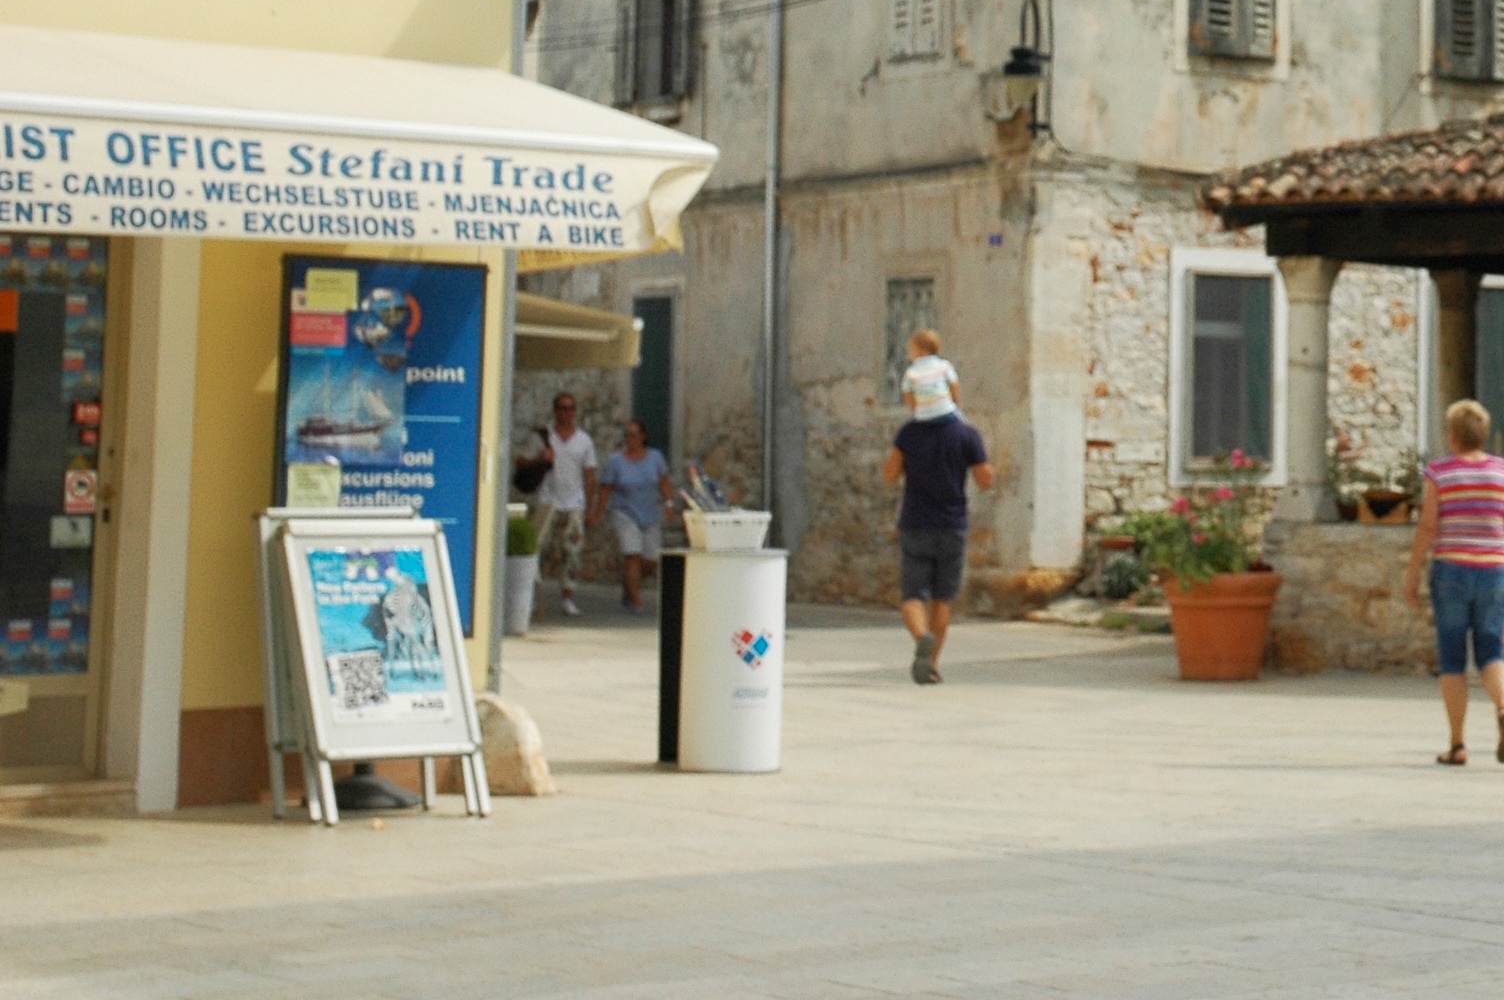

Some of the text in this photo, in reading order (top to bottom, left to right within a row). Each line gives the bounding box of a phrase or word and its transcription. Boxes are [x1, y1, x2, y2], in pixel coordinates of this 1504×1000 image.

[4, 125, 614, 194] IST OFFICE Stefani Trade
[62, 174, 176, 199] CAMBIO
[202, 180, 420, 211] WECHSELSTUBE
[110, 206, 208, 232] ROOMS
[244, 211, 416, 238] EXCURSIONS
[455, 221, 521, 242] RENT
[537, 225, 553, 243] A
[568, 226, 625, 247] BIKE
[405, 366, 466, 384] point
